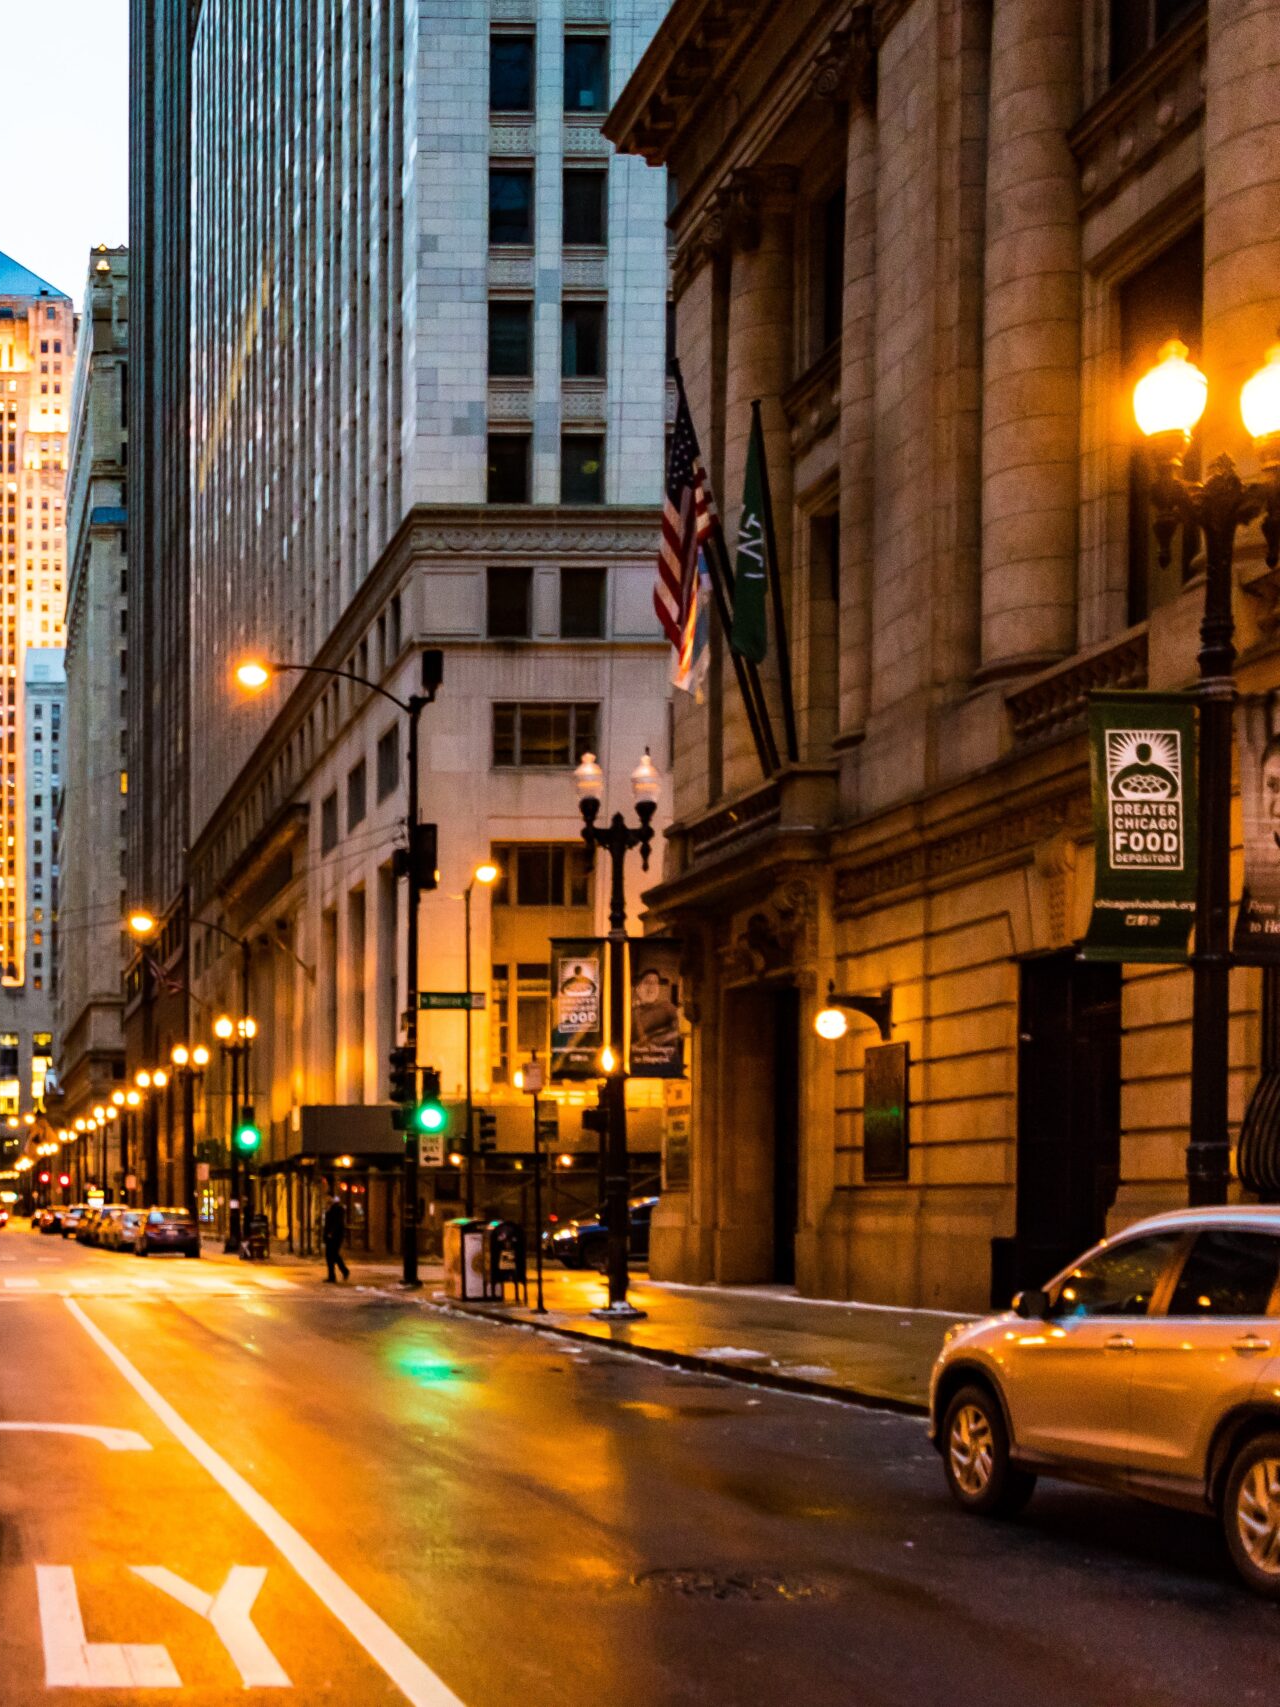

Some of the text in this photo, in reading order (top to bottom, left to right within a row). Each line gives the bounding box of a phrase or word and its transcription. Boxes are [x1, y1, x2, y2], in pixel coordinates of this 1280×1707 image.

[1114, 803, 1177, 816] GREATER
[1114, 818, 1178, 830] CHICAGO
[1114, 831, 1178, 852] FOOD
[1115, 853, 1178, 863] DEPOSITORY
[1250, 921, 1262, 933] to
[561, 1011, 597, 1024] FOOD
